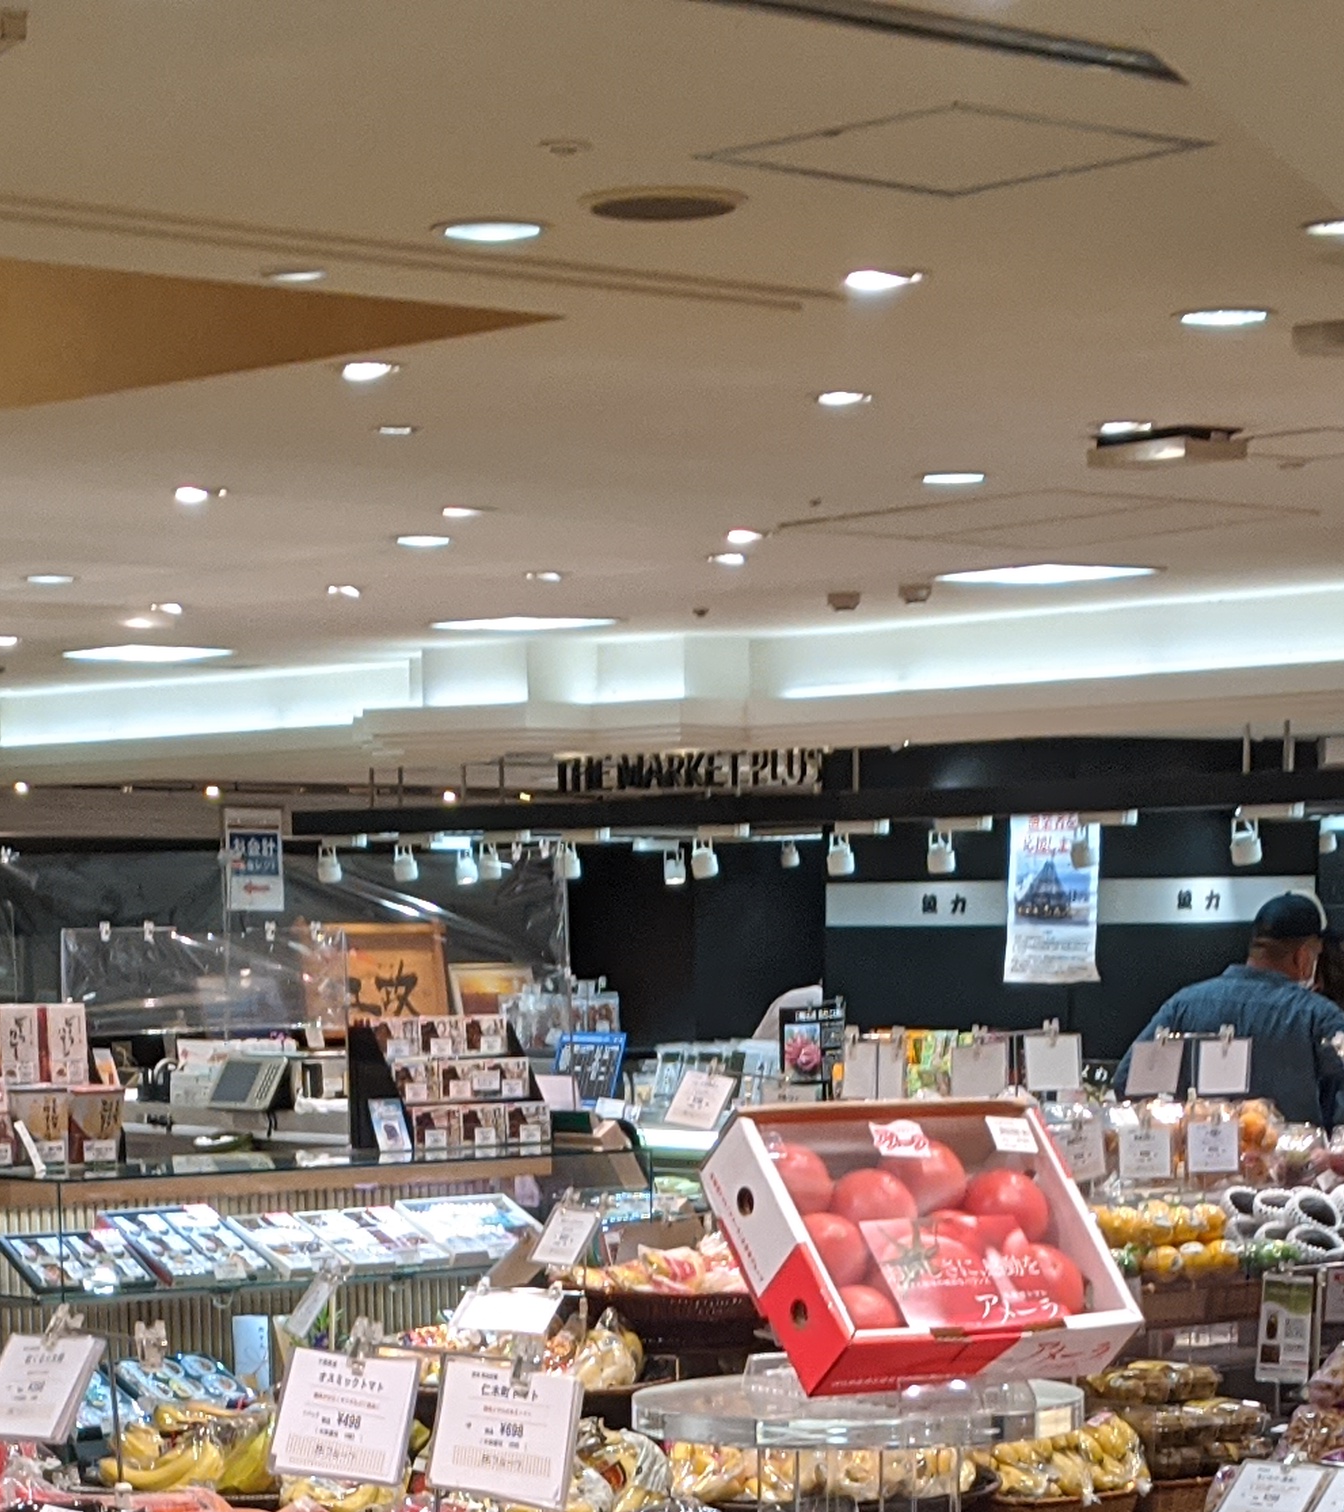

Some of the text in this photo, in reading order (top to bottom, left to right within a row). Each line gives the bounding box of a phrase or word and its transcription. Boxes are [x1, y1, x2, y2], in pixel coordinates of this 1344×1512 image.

[558, 747, 823, 792] THE MARKET PLUS
[975, 1290, 1061, 1324] アメーラ
[318, 1372, 384, 1392] オスミックトマト
